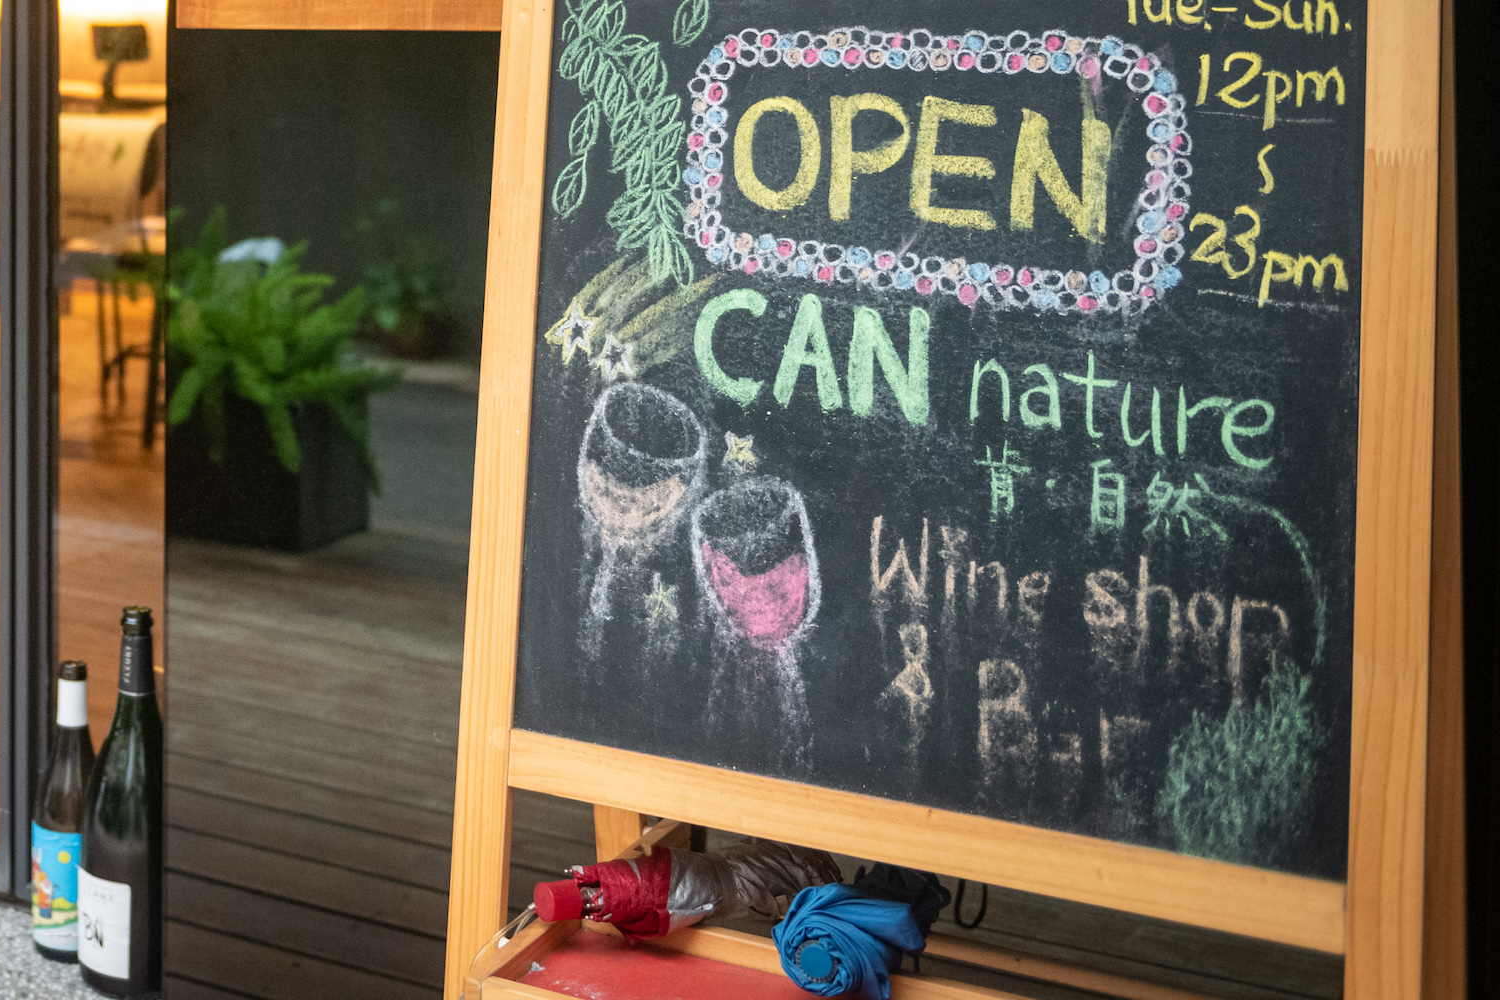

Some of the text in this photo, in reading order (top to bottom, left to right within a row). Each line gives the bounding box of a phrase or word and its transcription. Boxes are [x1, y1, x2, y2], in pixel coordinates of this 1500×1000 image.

[1195, 52, 1346, 131] 12pm
[733, 92, 1112, 245] OPEN
[1190, 205, 1349, 308] 23pm
[694, 288, 1275, 470] CAN nature
[869, 515, 1051, 622] Wine
